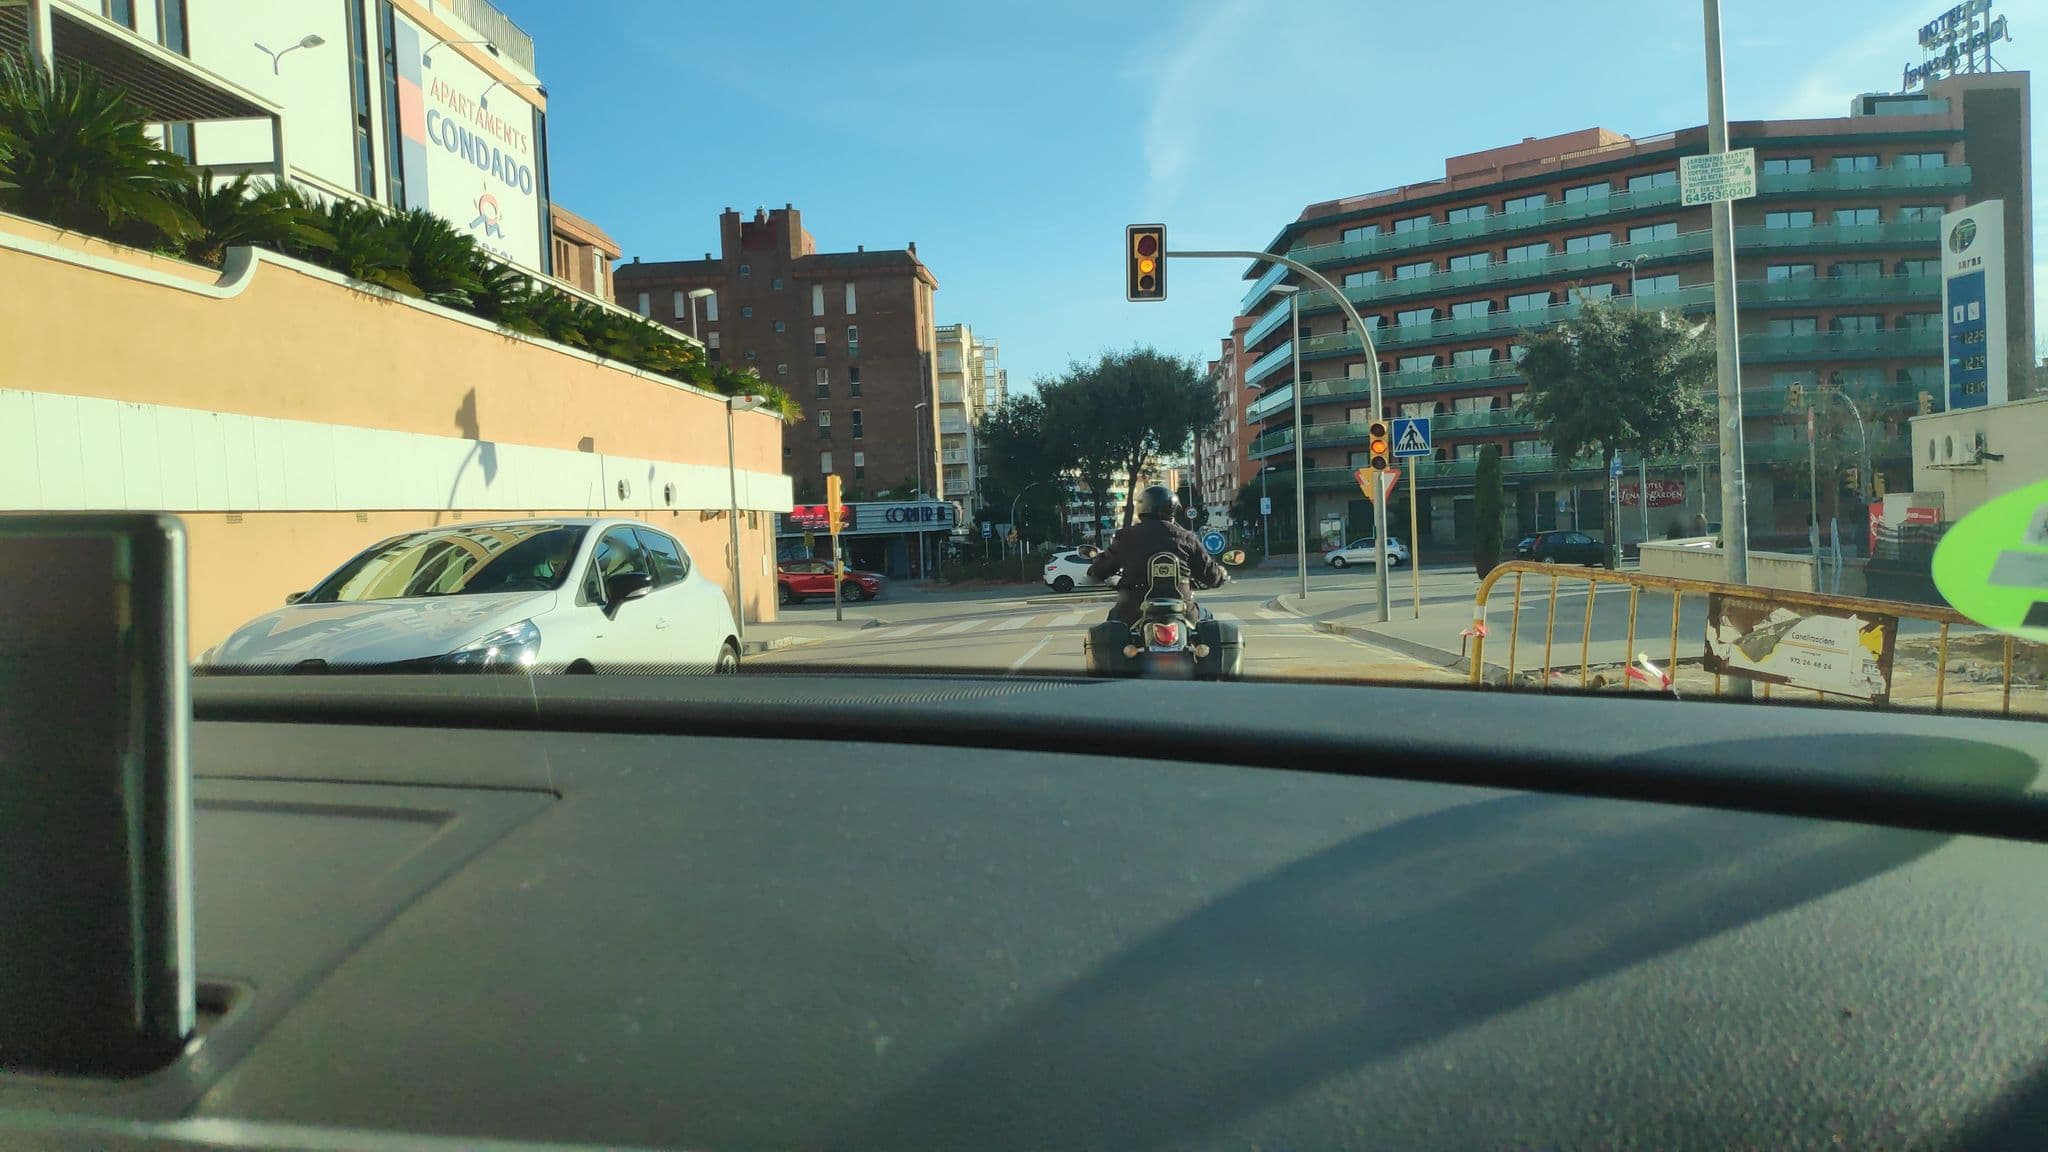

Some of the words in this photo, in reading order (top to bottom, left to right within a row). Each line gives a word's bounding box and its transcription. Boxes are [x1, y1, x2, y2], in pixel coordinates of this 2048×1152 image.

[427, 108, 533, 196] CONDADO
[430, 77, 527, 155] APARTAMENTS
[1685, 187, 1751, 204] 645636040
